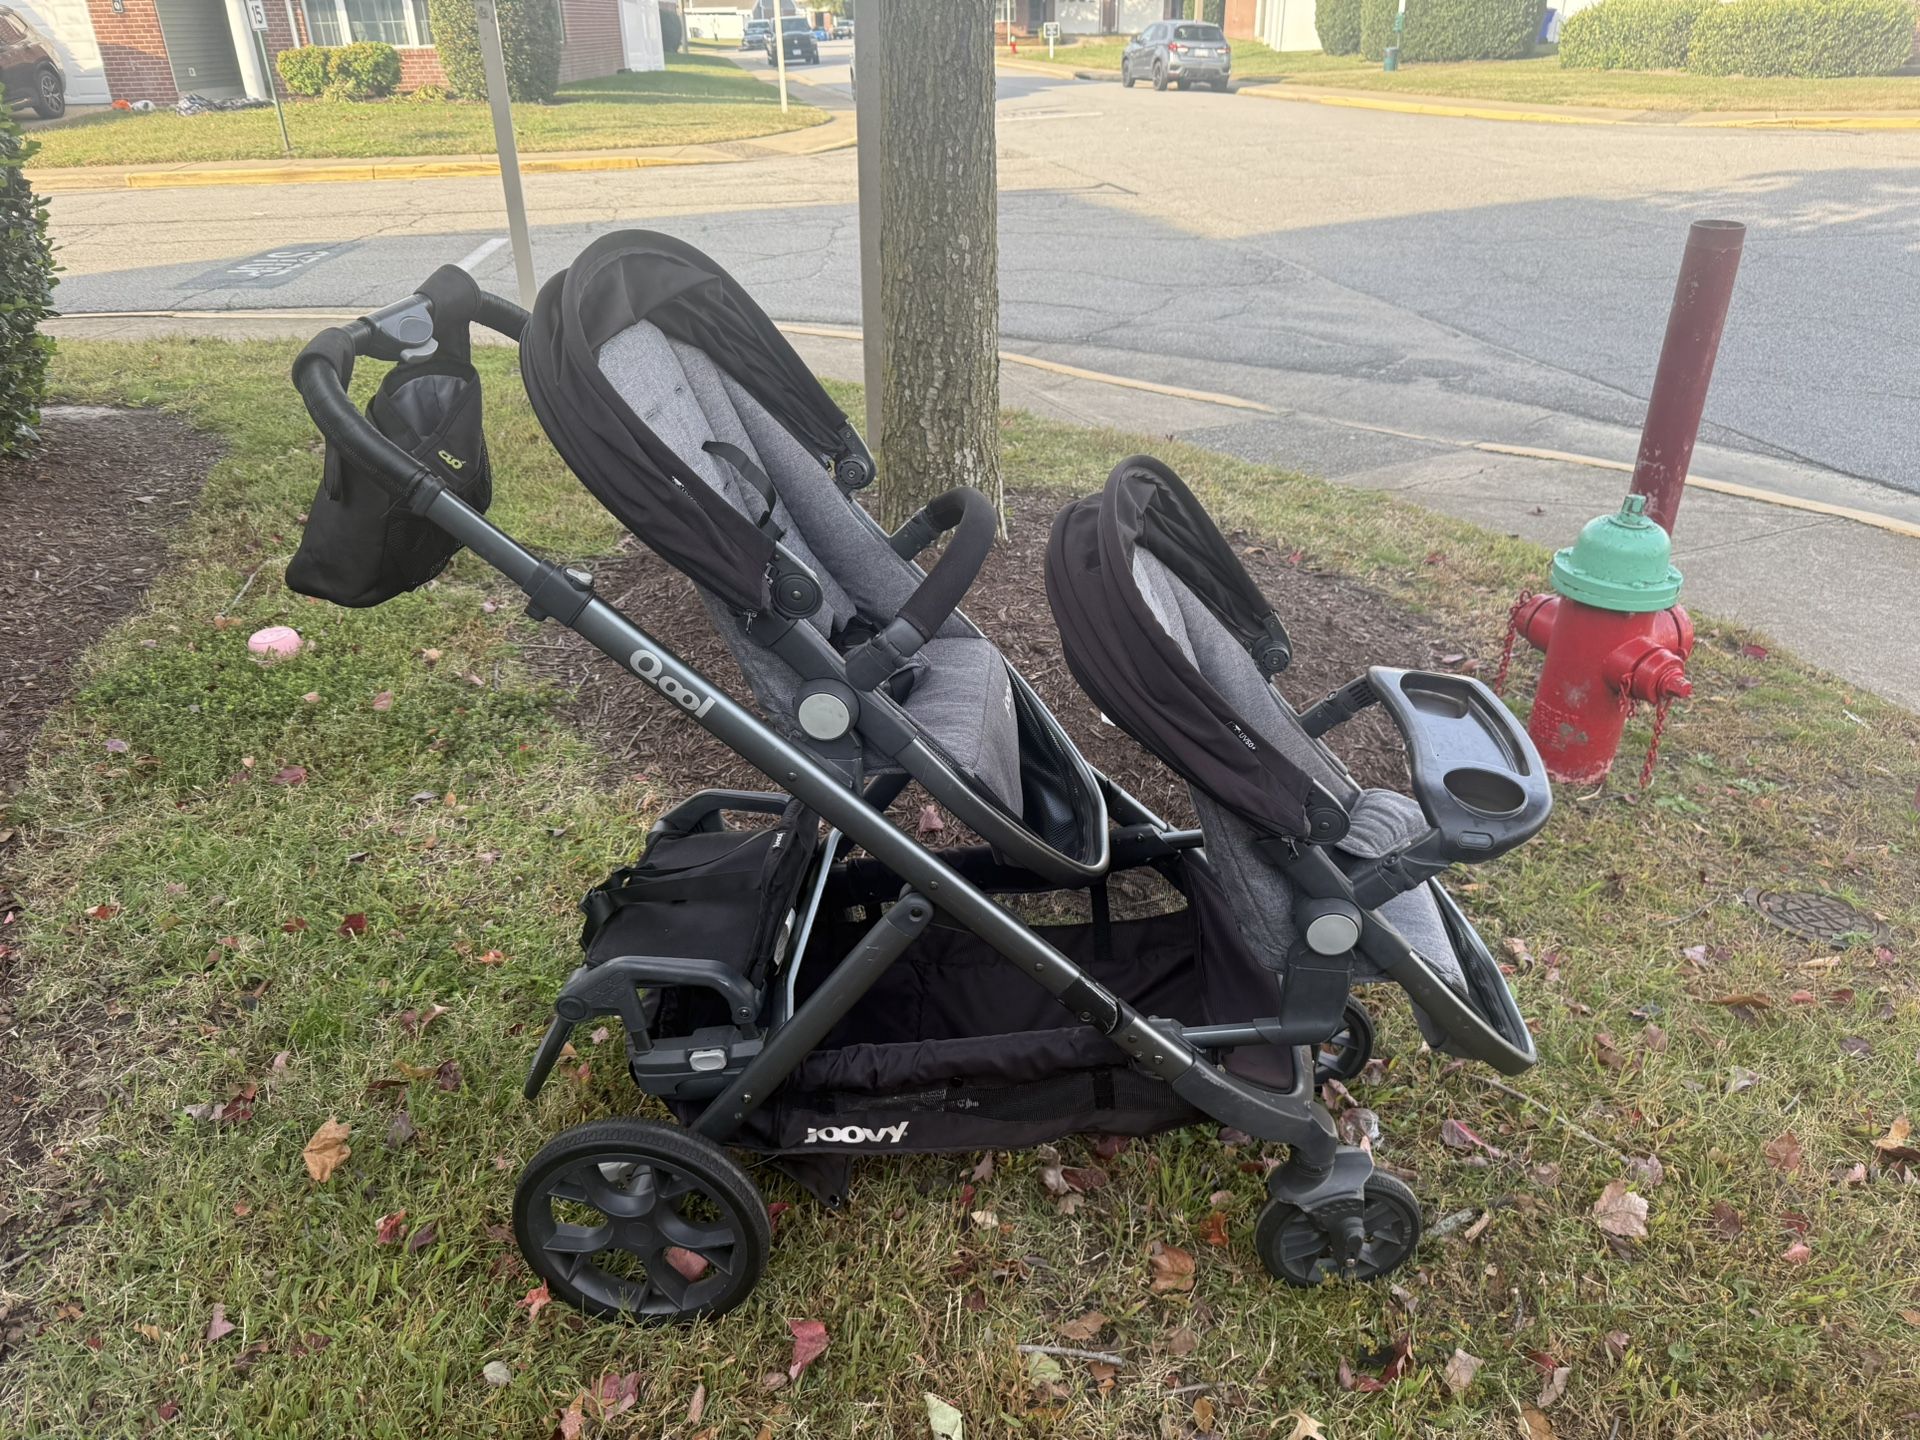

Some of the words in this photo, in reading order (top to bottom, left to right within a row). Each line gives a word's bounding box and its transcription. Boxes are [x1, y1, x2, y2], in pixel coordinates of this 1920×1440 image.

[251, 5, 264, 24] 15
[629, 649, 716, 719] Qool
[804, 1121, 909, 1144] JOOVY
